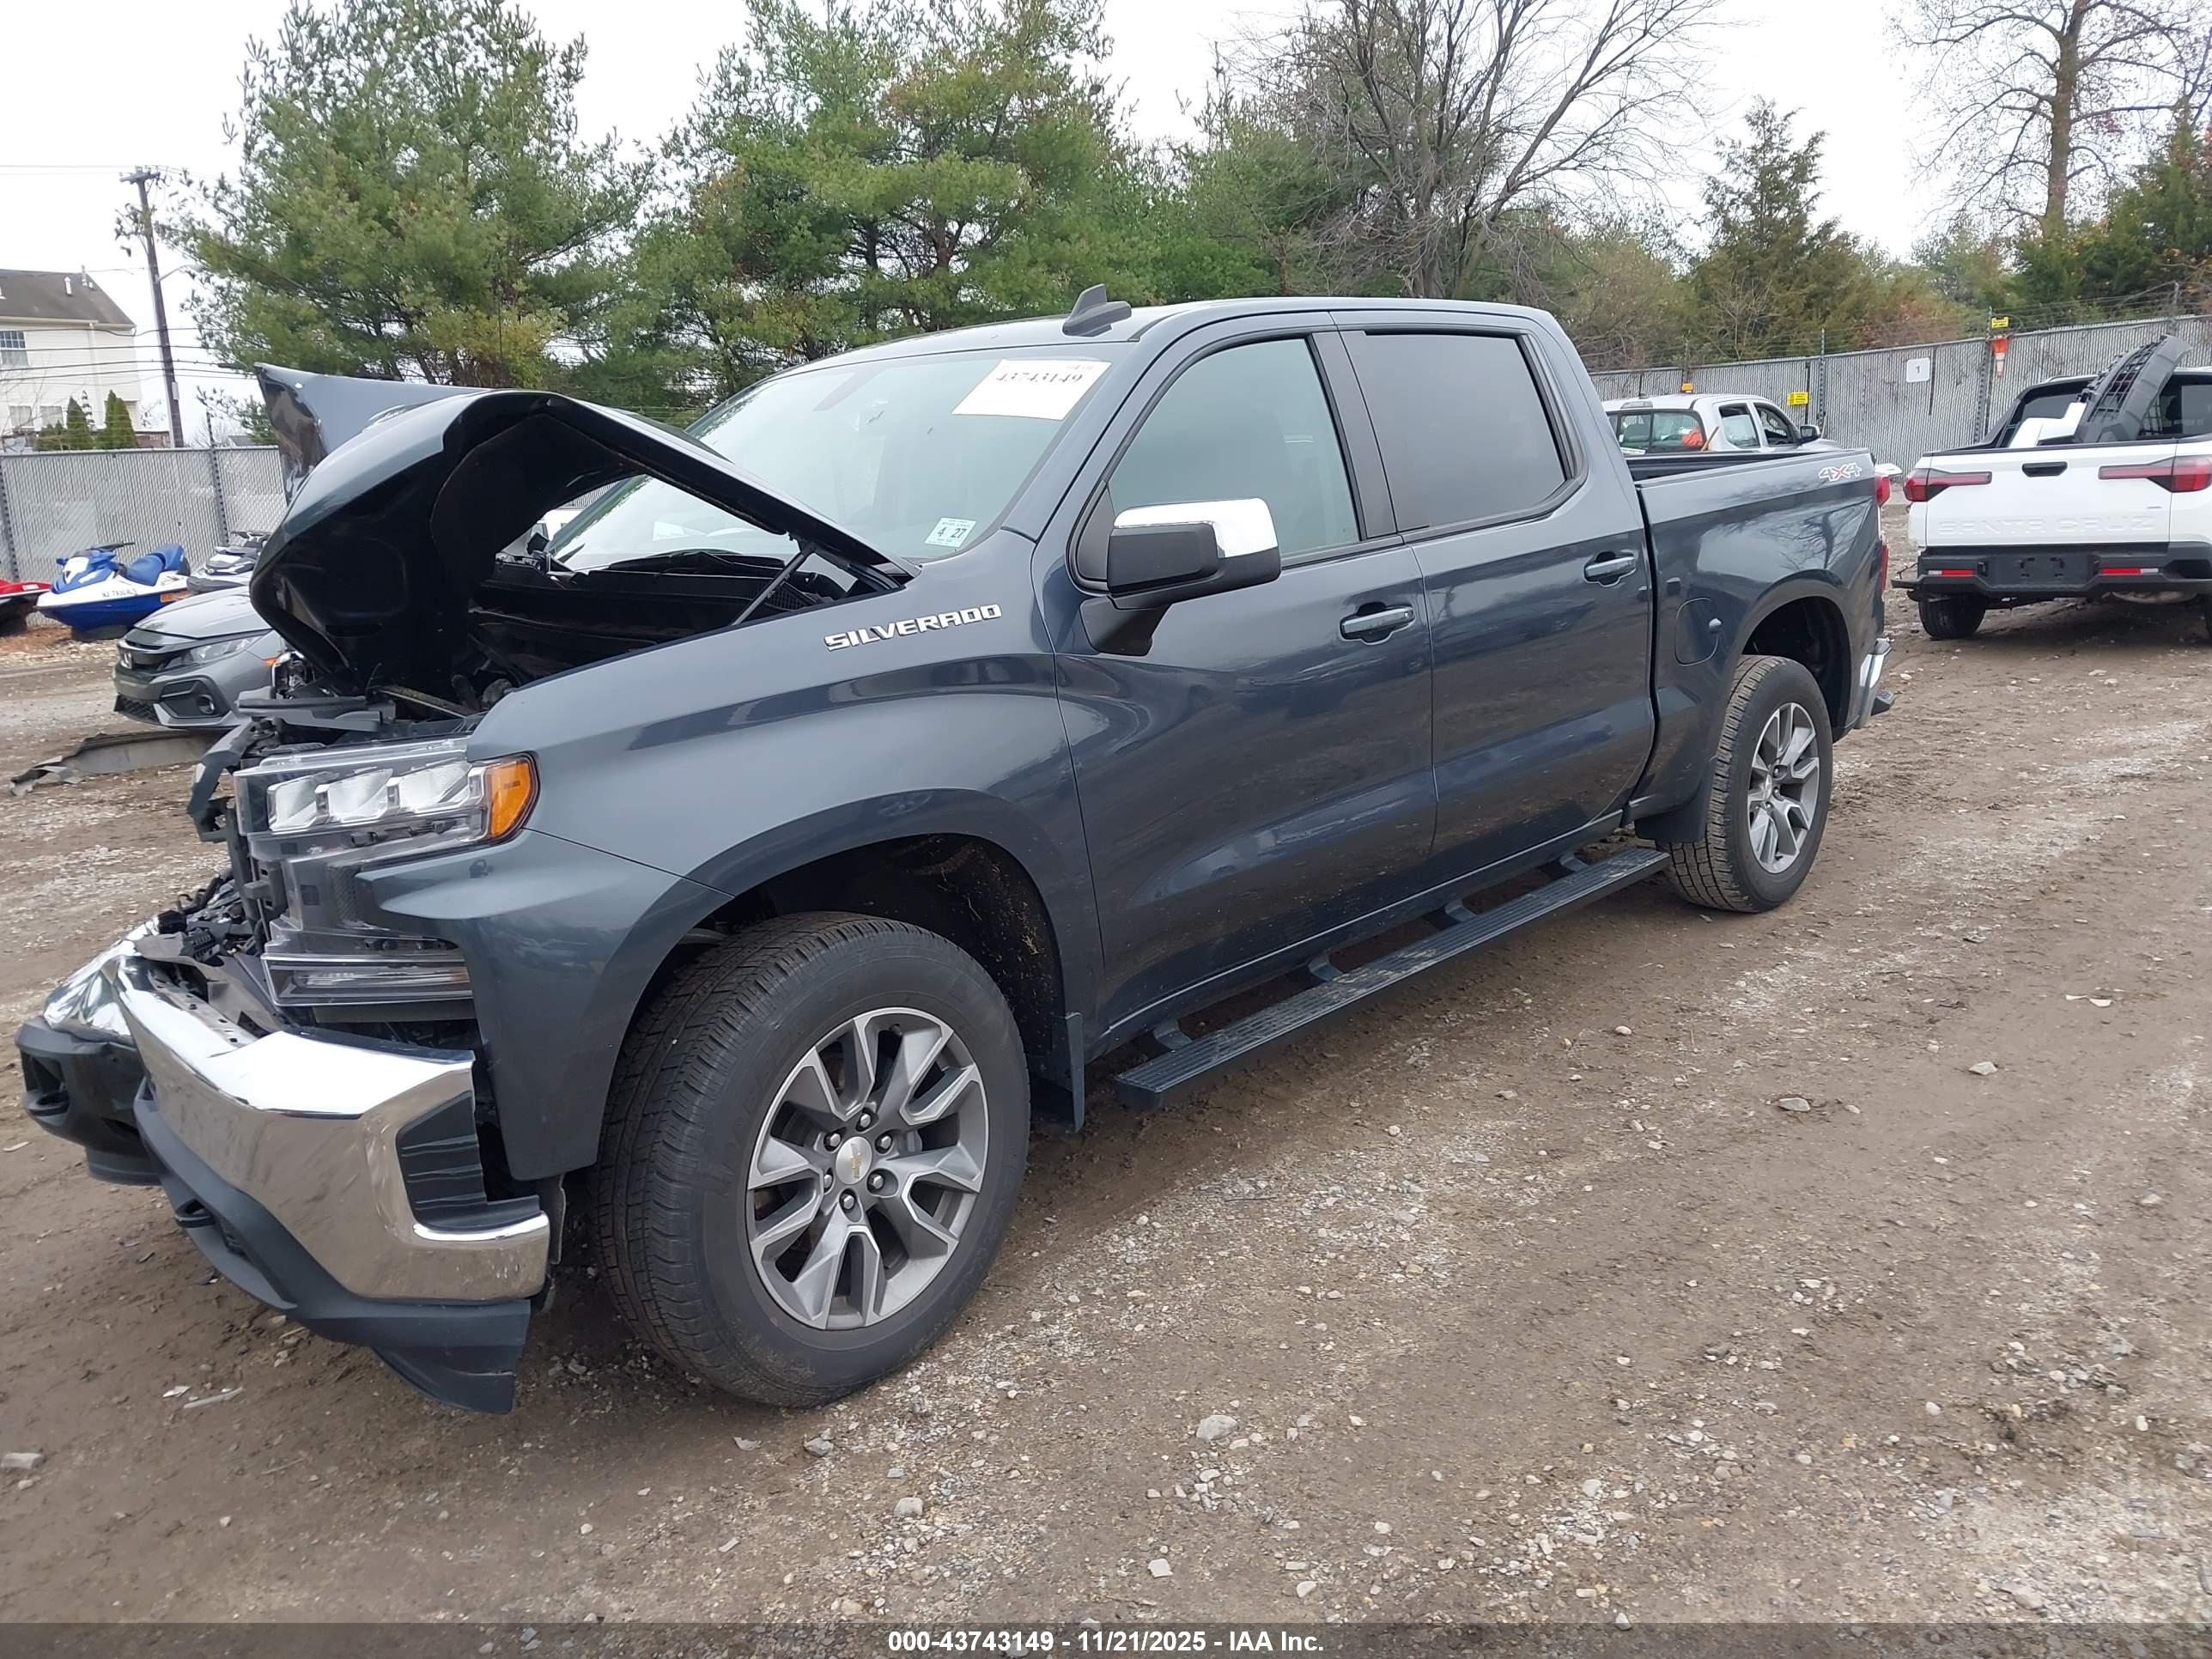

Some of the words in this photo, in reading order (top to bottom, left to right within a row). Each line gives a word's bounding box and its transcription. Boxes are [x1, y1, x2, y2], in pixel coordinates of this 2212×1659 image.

[1915, 365, 1921, 374] 1
[937, 526, 947, 538] 4
[949, 527, 969, 538] 27
[1937, 519, 2048, 535] SANTA
[2056, 516, 2155, 532] CRUZ
[823, 604, 1003, 652] SILVERADO
